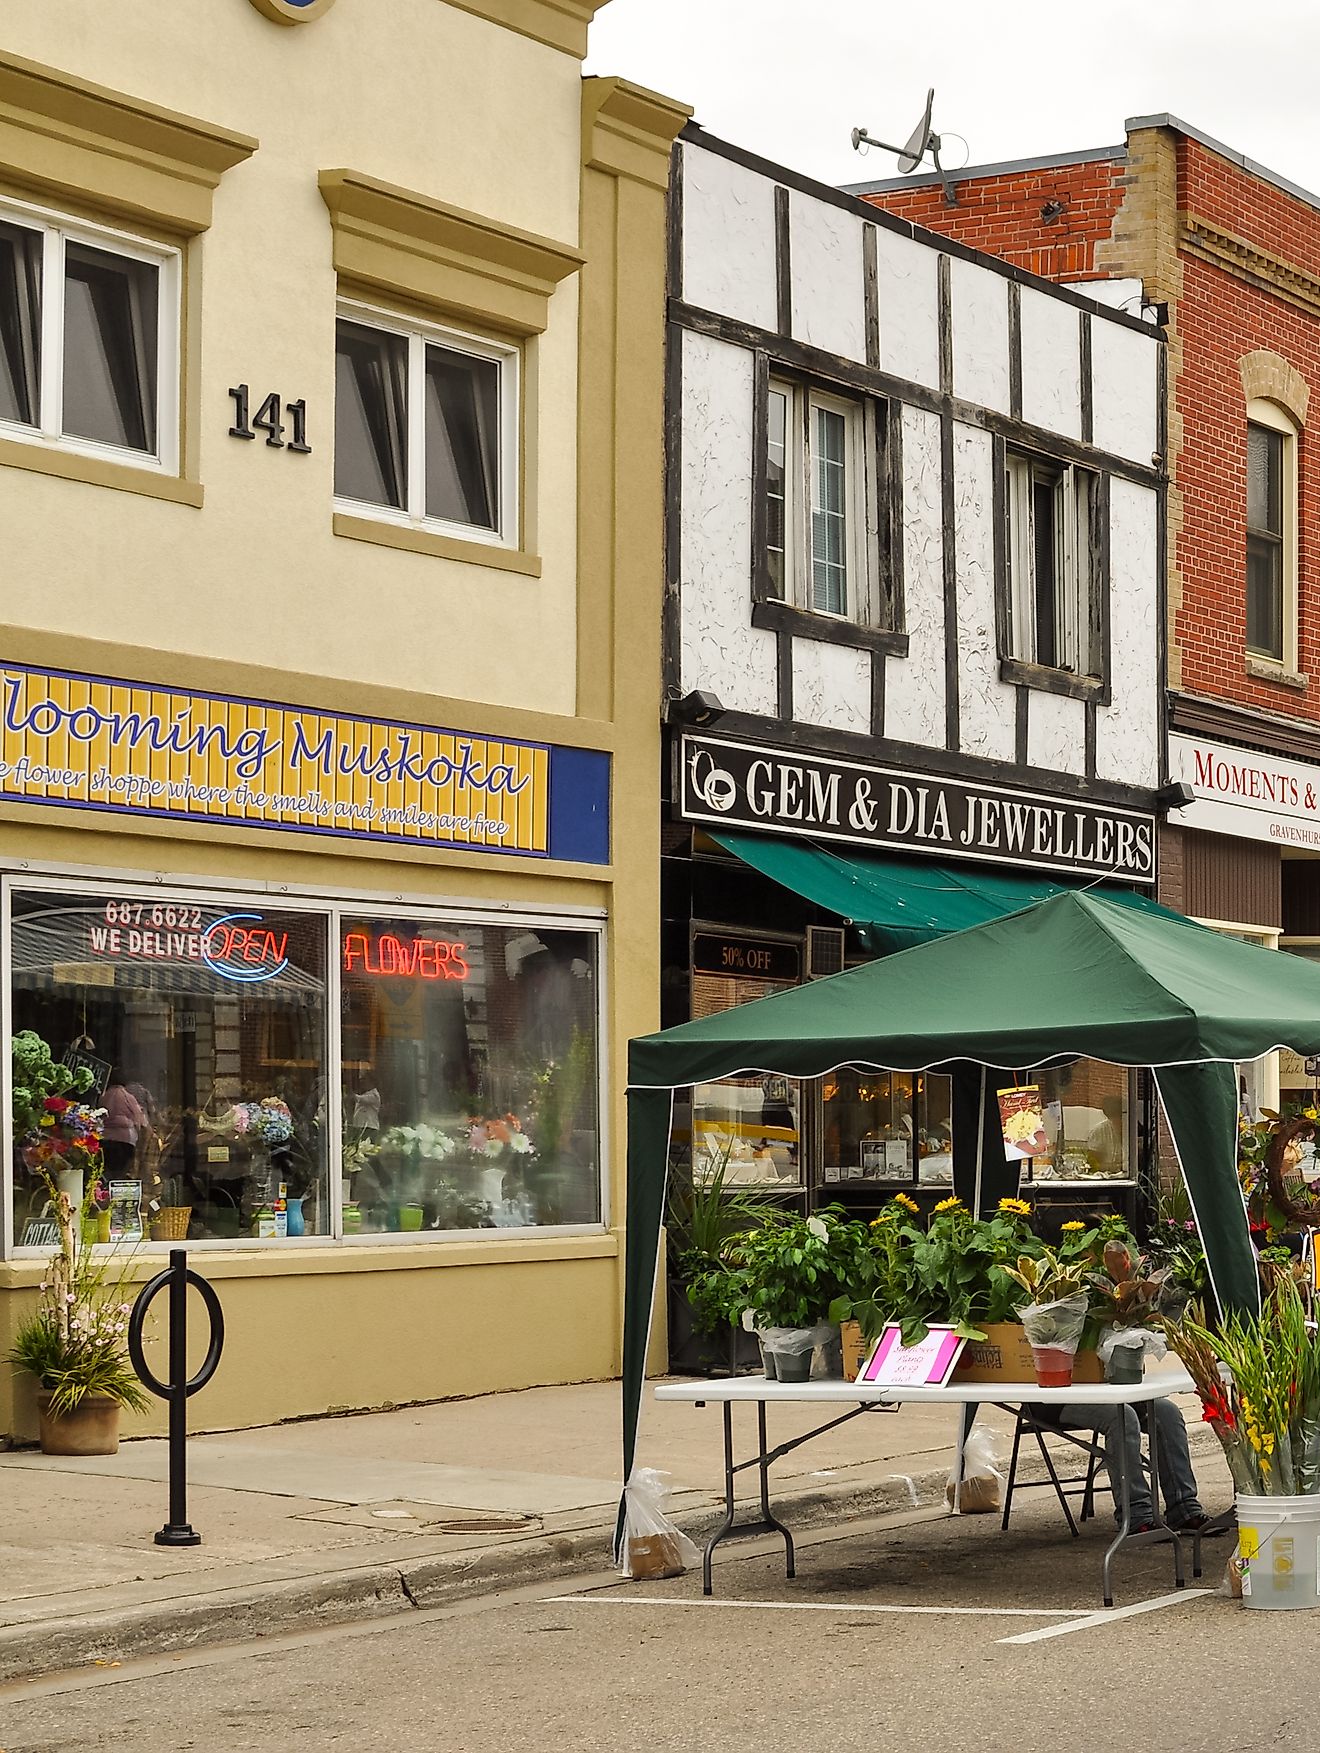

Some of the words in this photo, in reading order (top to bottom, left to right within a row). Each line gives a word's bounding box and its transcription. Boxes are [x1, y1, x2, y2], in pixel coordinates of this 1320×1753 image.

[228, 384, 311, 453] 141
[291, 721, 529, 794] Muskoka
[1193, 750, 1299, 806] MOMENTS
[1304, 782, 1317, 810] &
[15, 758, 86, 785] flower
[91, 768, 163, 798] shoppe
[169, 776, 232, 802] where
[235, 783, 268, 806] the
[271, 793, 332, 815] smells
[334, 800, 378, 820] and
[381, 805, 437, 827] smiles
[439, 815, 473, 830] are
[473, 813, 509, 836] free
[746, 761, 842, 826] GEM
[849, 777, 880, 831] &
[886, 782, 952, 841] DIA
[960, 795, 1152, 872] JEWELLERS
[105, 900, 201, 929] 687.6622
[91, 927, 121, 953] WE
[129, 931, 212, 959] DELIVER
[209, 925, 288, 963] OPEN
[344, 932, 469, 979] FLOWERS
[722, 946, 744, 967] 50%
[747, 949, 771, 969] OFF
